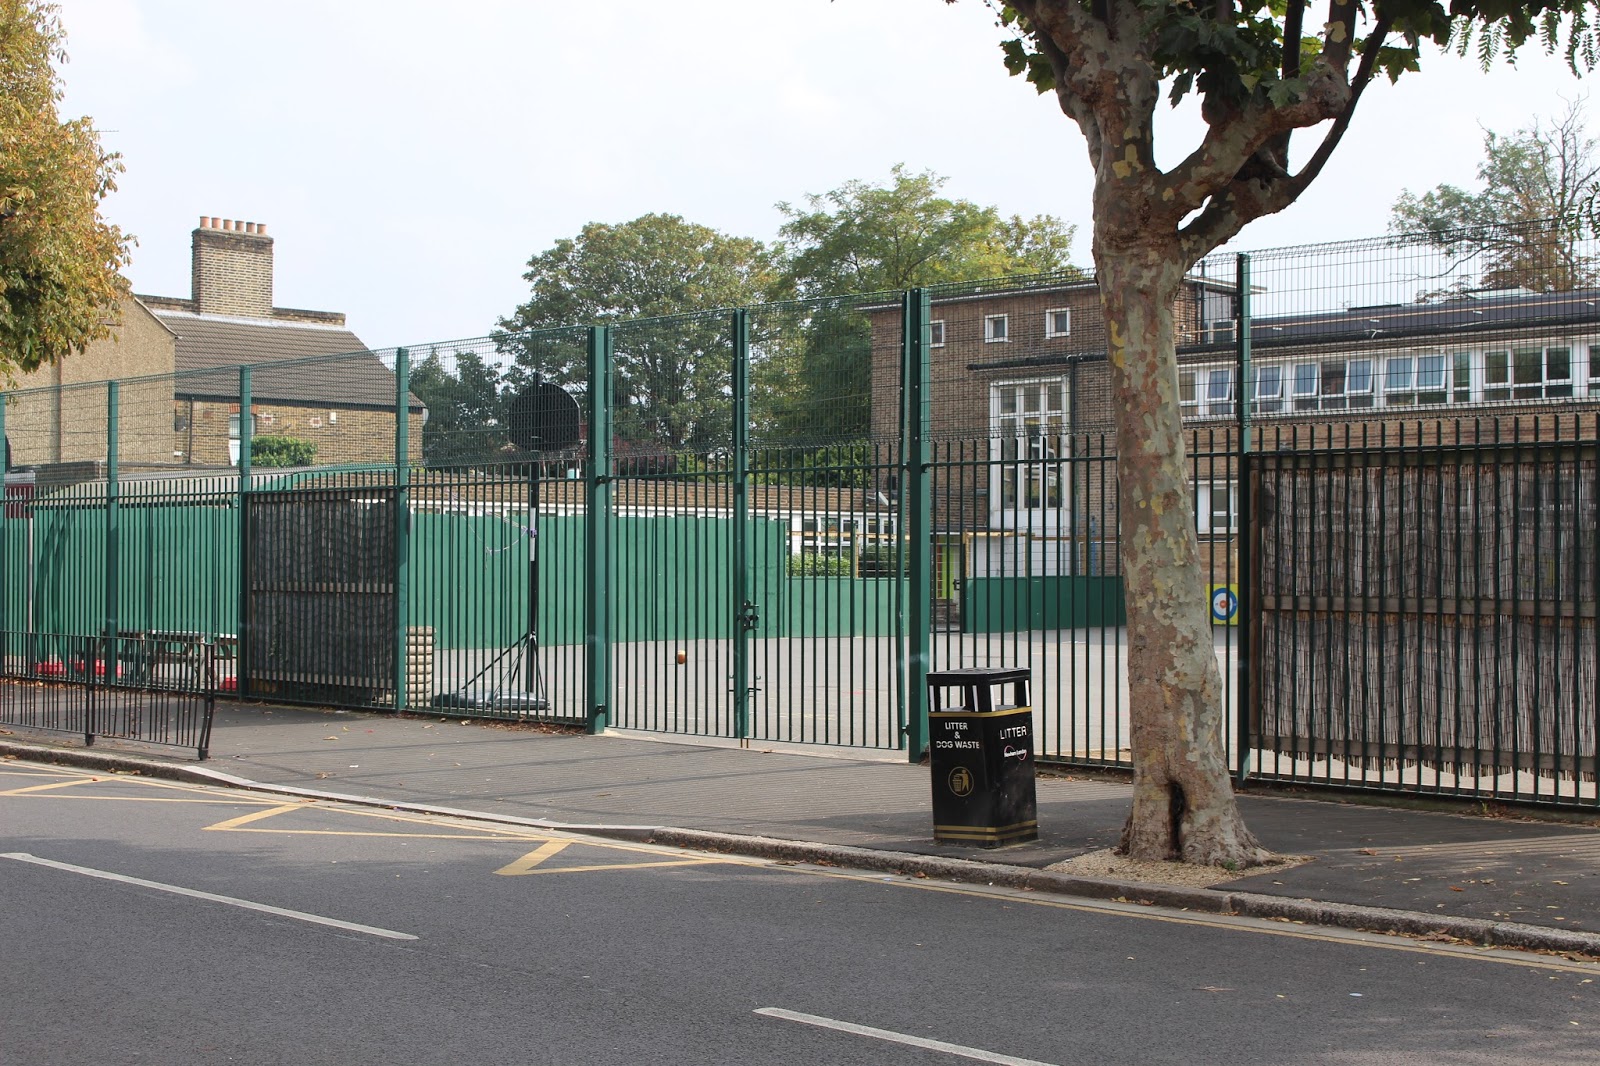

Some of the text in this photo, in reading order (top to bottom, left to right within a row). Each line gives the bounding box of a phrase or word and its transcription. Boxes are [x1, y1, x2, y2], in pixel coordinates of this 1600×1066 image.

[944, 722, 968, 730] LITTER
[954, 731, 961, 739] &
[1000, 726, 1027, 740] LITTER
[936, 740, 980, 749] DOG WASTE
